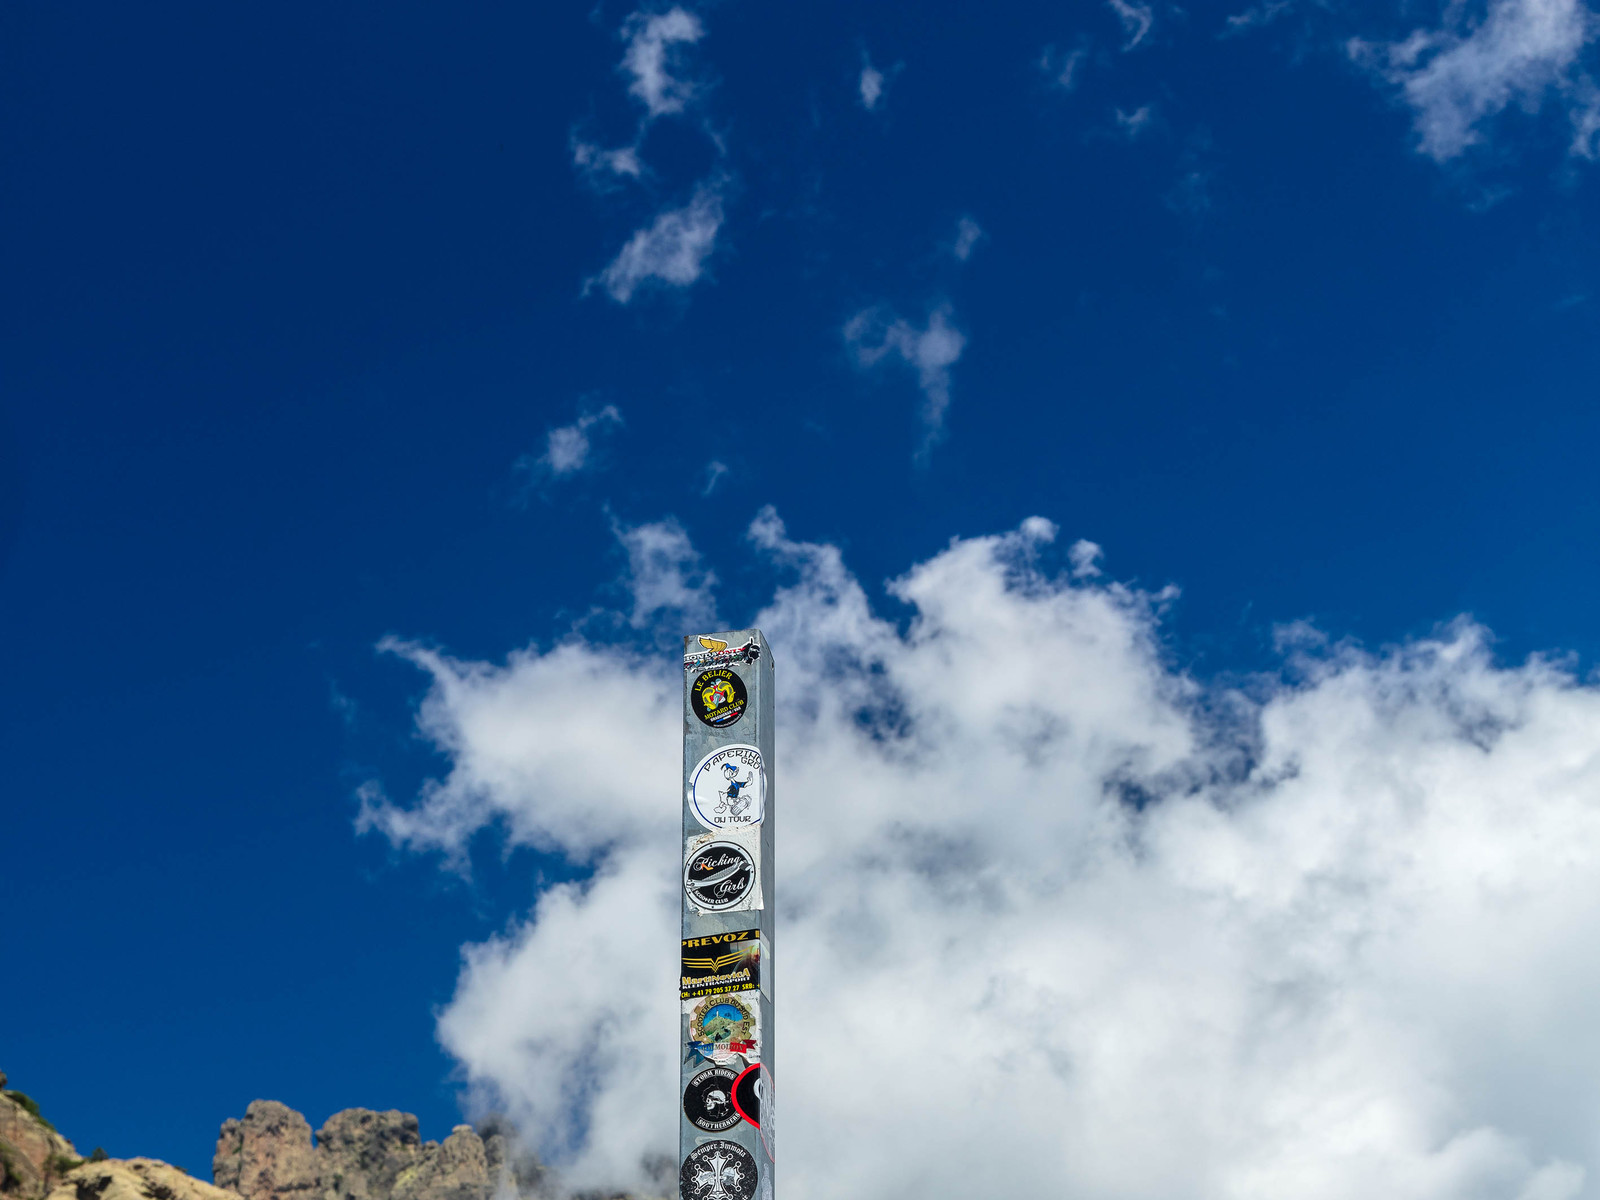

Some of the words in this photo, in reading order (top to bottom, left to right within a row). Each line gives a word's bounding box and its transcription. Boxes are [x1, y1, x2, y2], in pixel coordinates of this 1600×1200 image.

[694, 680, 704, 692] LE
[702, 670, 733, 682] BELIER
[704, 706, 729, 720] MOTARD
[728, 700, 745, 710] CLUB
[709, 998, 730, 1010] CLUB
[730, 998, 740, 1009] DU
[740, 1005, 749, 1021] SUD
[694, 1070, 713, 1086] STORM
[714, 1069, 735, 1081] RIDERS
